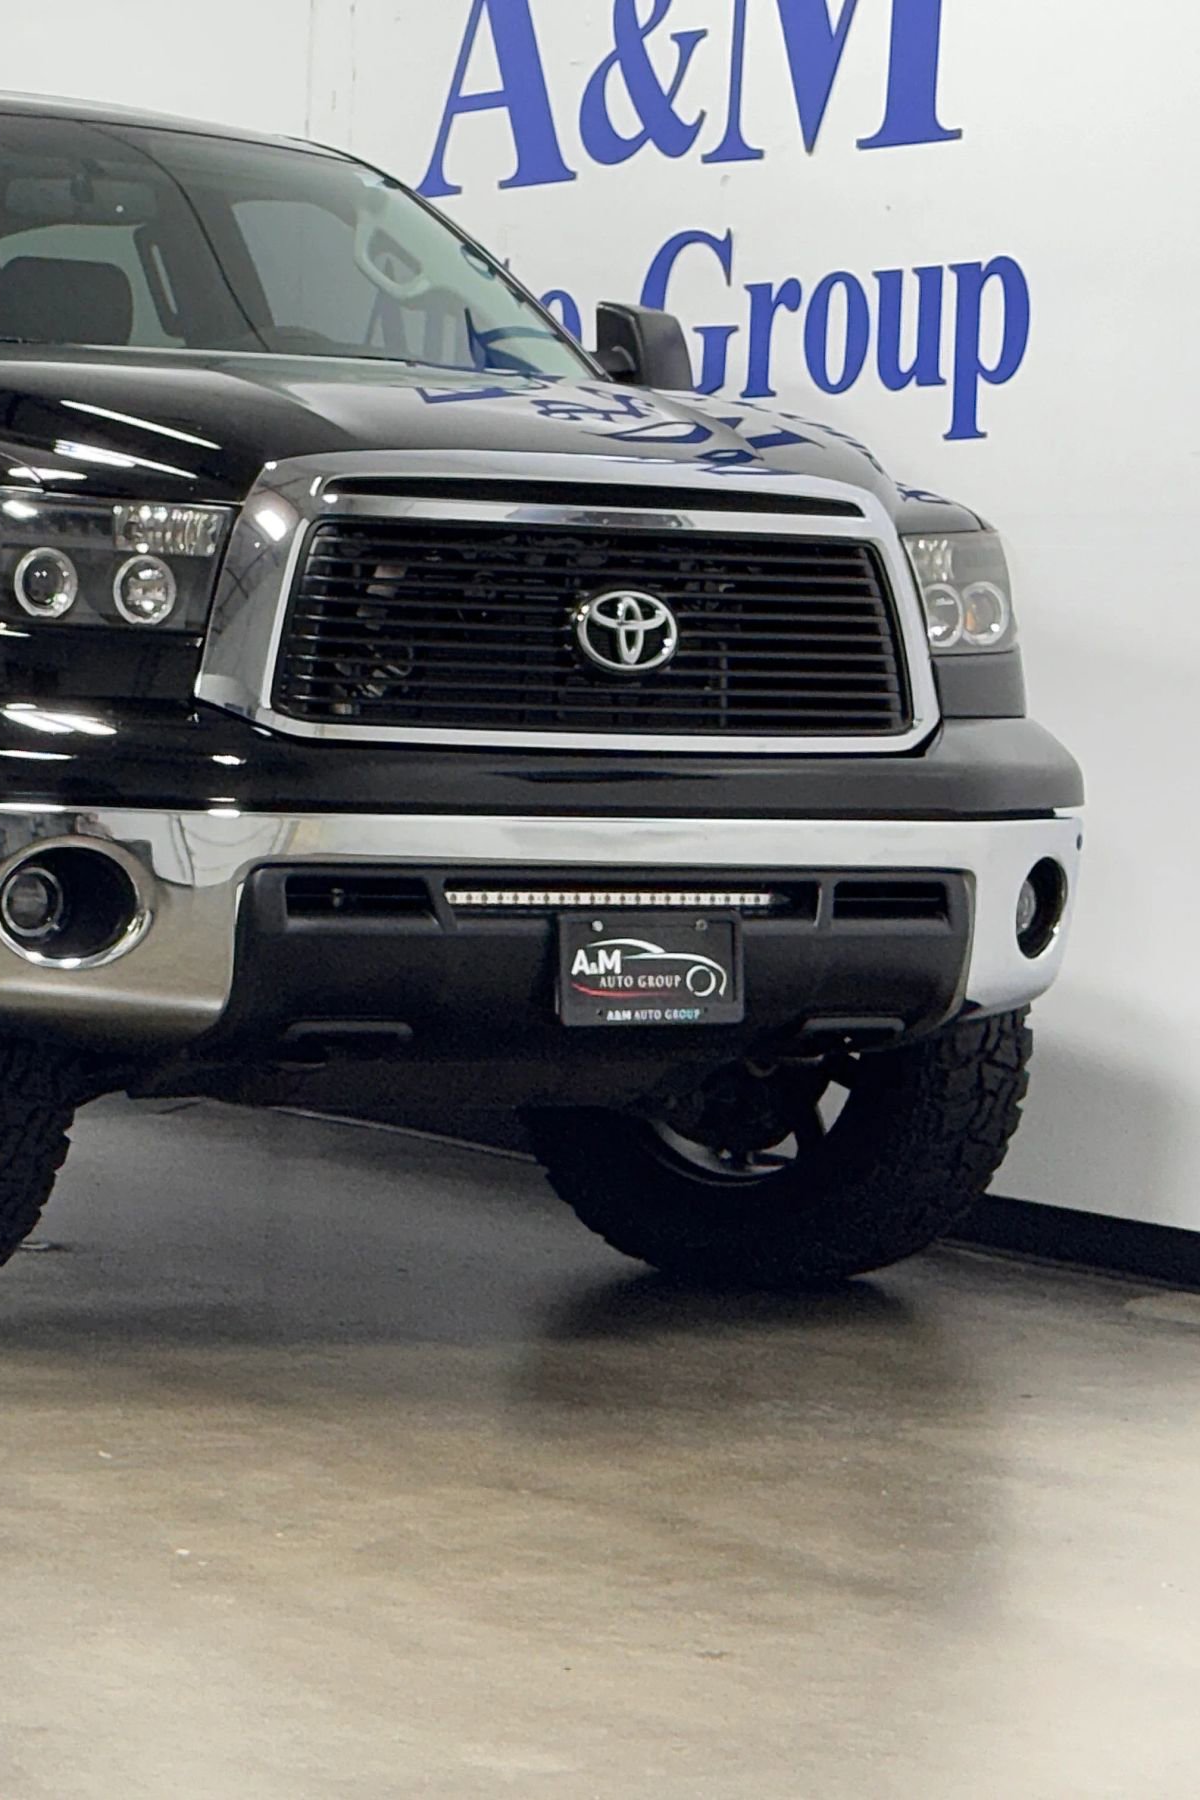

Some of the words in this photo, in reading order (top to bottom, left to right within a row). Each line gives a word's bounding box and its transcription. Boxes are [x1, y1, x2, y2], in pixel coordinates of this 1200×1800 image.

[411, 0, 963, 197] A&M
[640, 227, 1031, 441] Group
[571, 949, 621, 975] A&M
[599, 975, 634, 988] AUTO
[637, 975, 682, 988] GROUP
[634, 1009, 662, 1021] AUTO
[664, 1008, 701, 1021] GROUP
